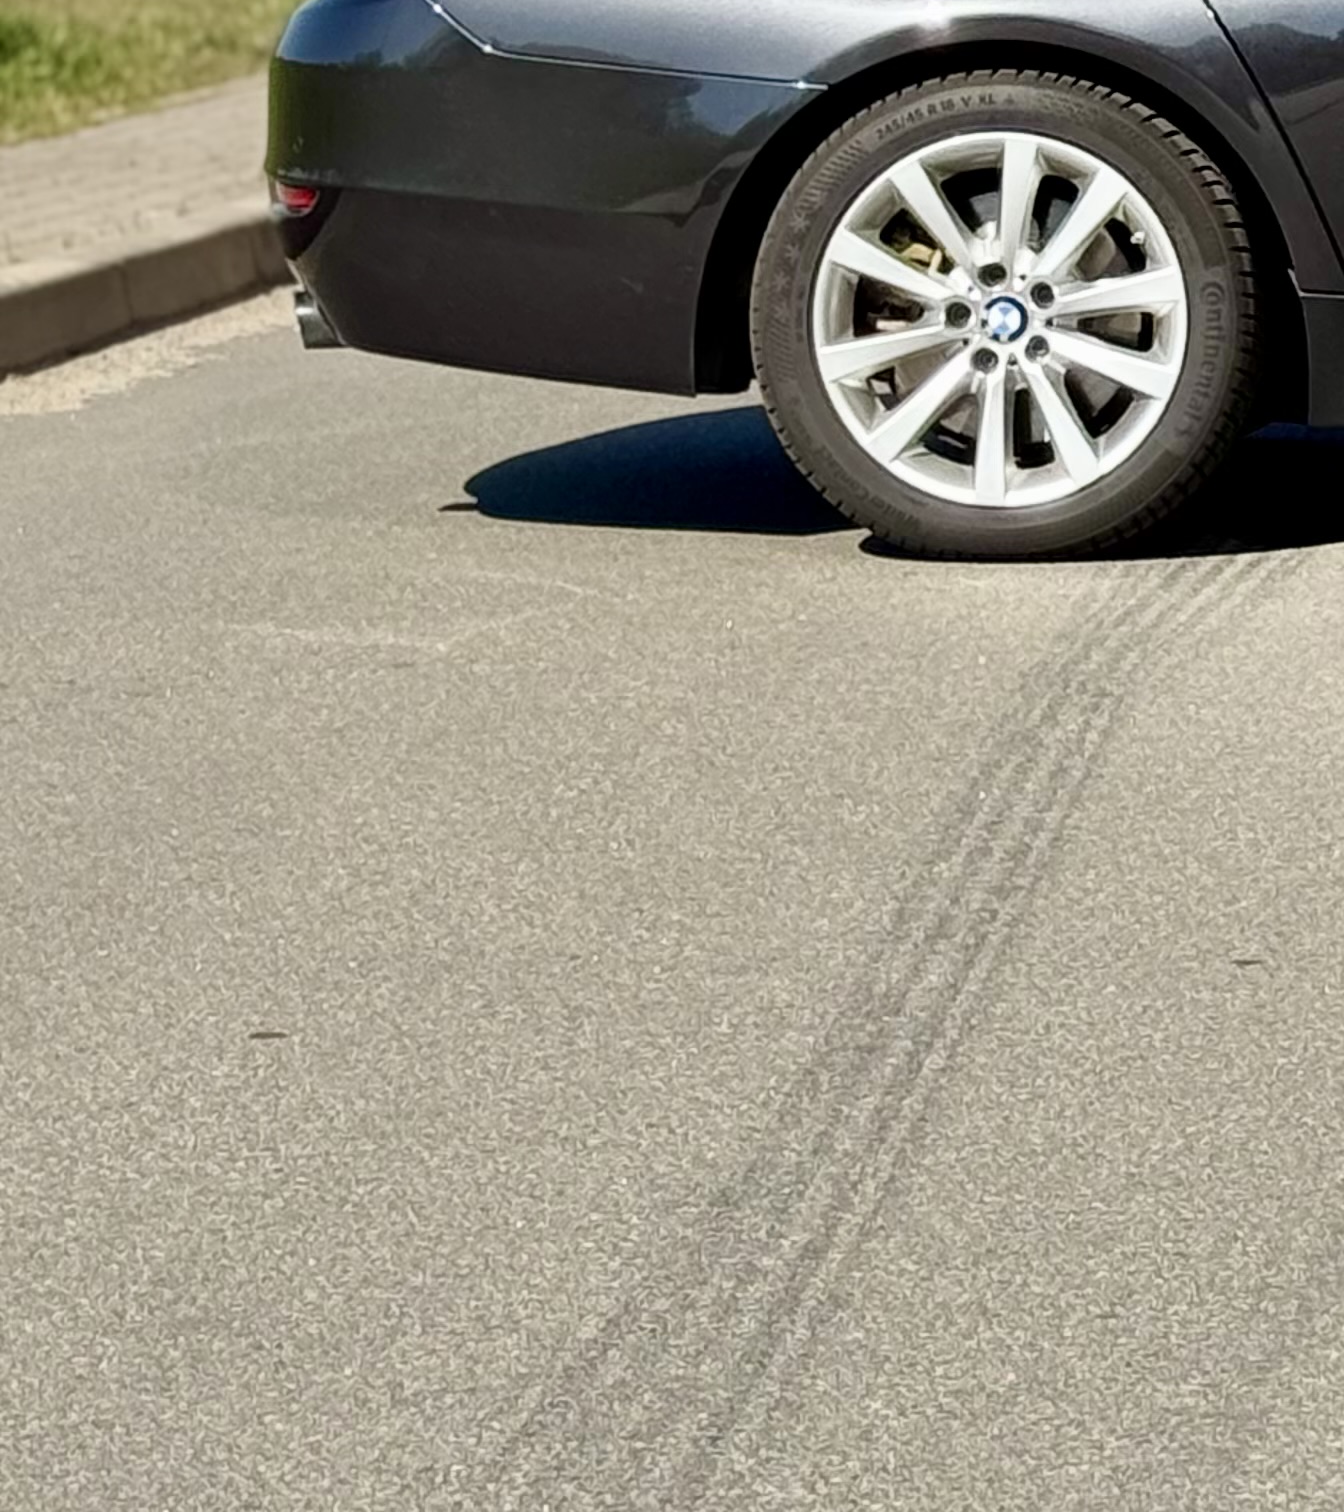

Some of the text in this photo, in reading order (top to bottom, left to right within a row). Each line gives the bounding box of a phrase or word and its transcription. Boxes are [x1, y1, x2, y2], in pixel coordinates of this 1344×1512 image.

[875, 105, 924, 139] 245/45
[960, 95, 974, 109] V
[1182, 280, 1226, 422] Continental
